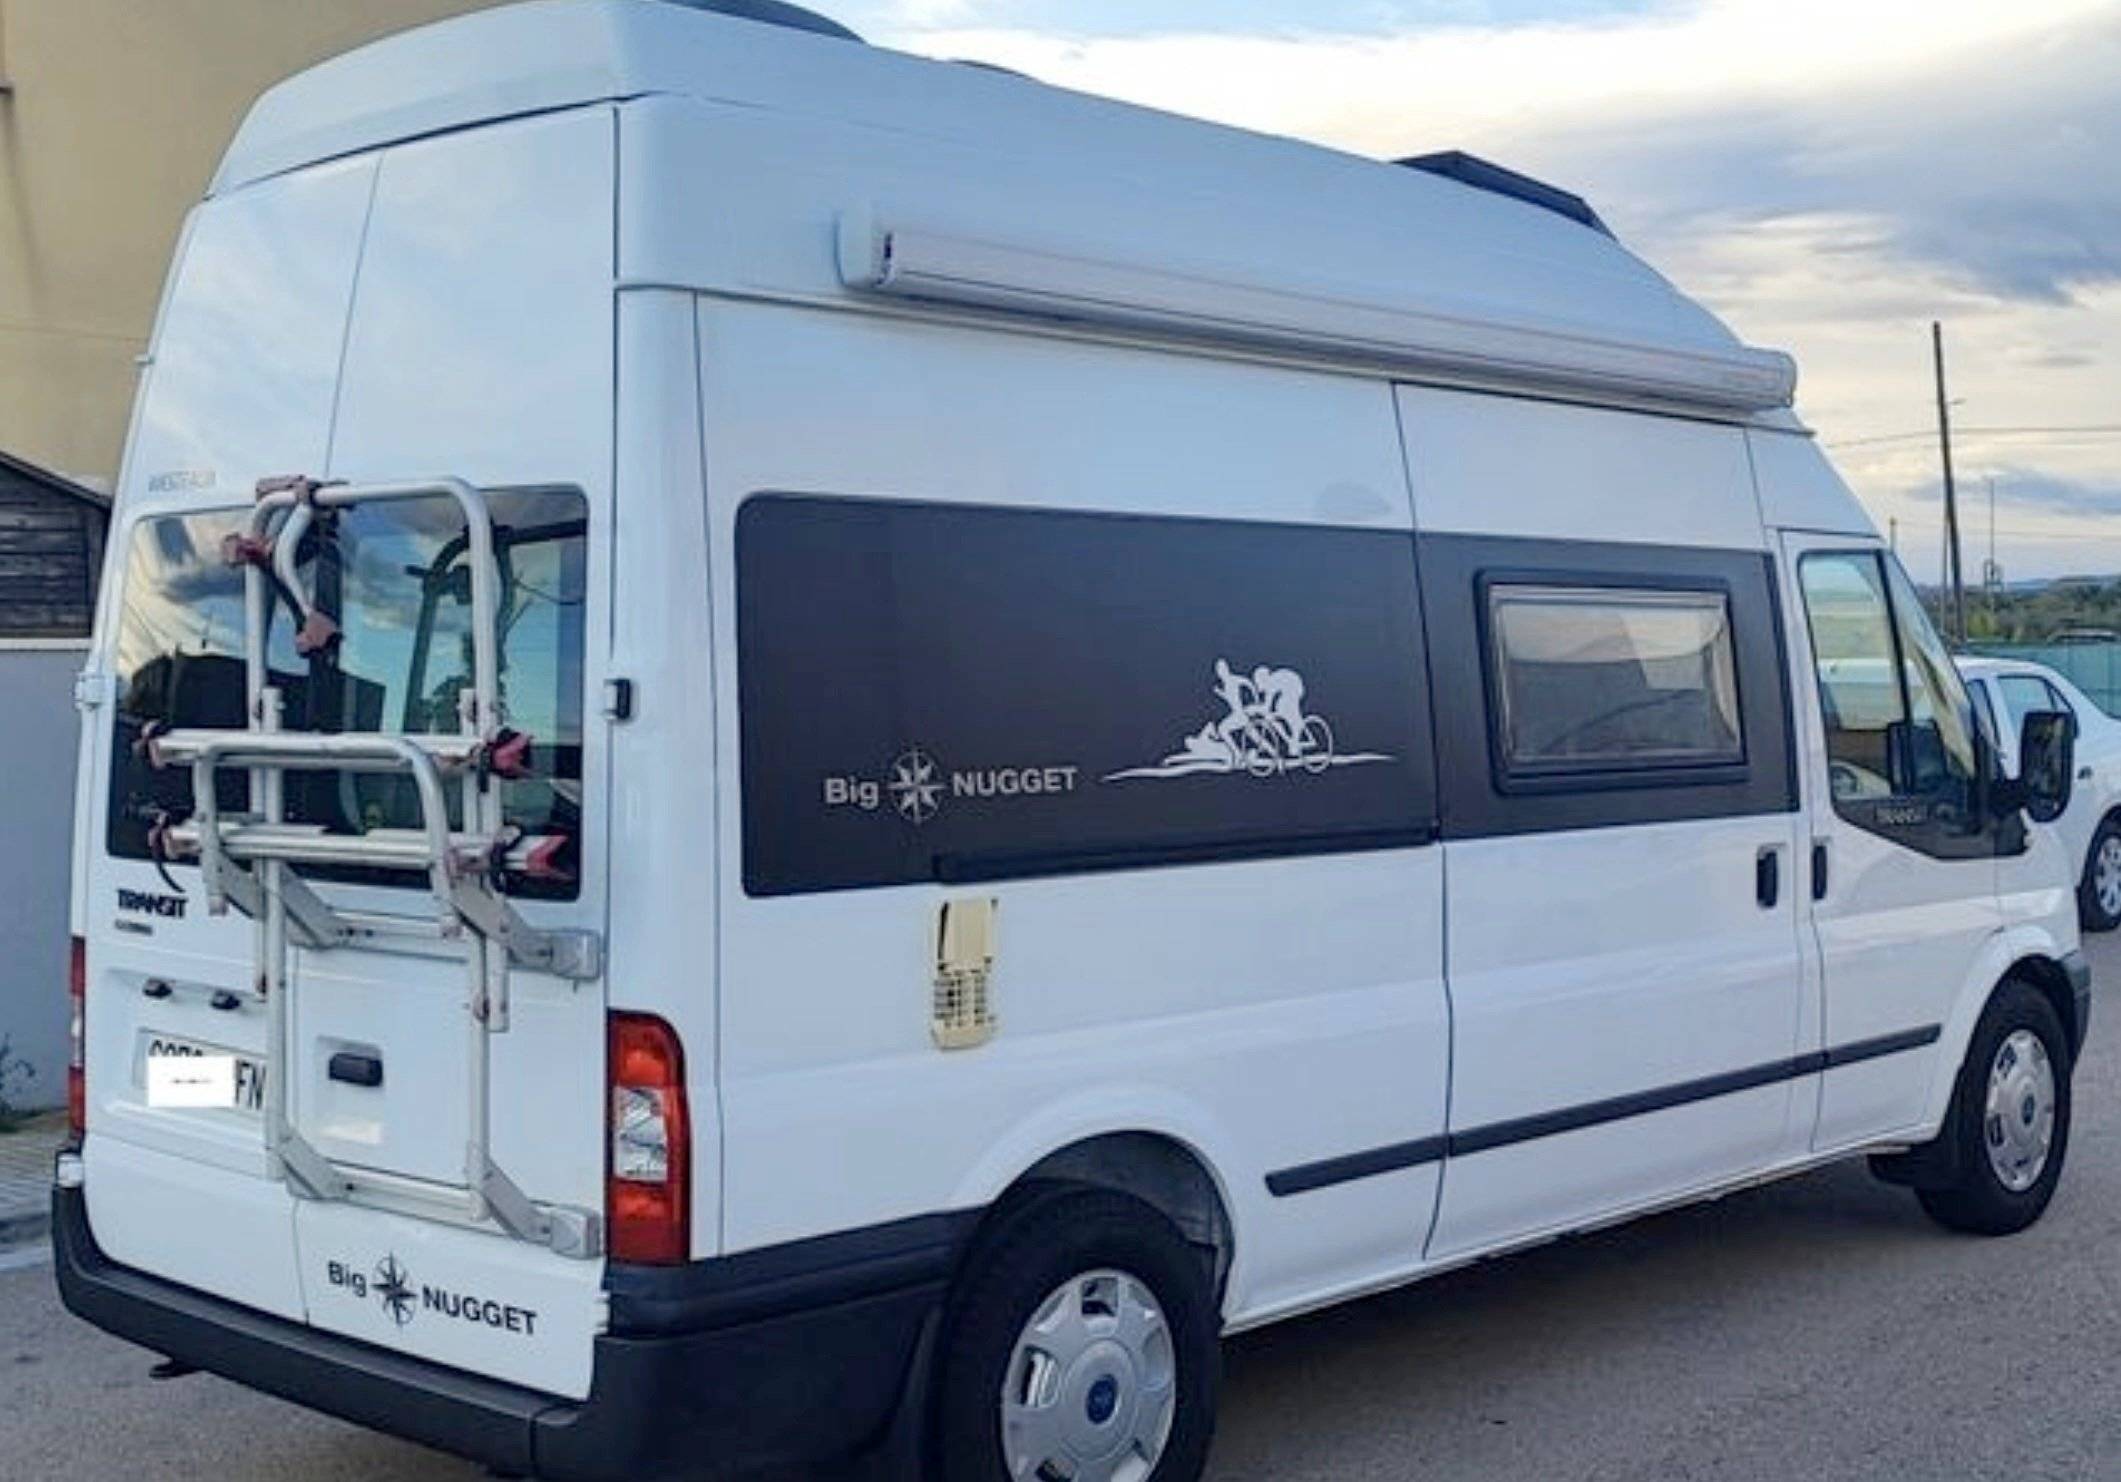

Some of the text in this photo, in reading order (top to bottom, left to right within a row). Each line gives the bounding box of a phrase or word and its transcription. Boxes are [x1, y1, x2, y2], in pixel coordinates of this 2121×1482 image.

[825, 766, 1078, 809] Big NUGGET
[117, 888, 188, 919] TRANSIT
[328, 1260, 537, 1334] Big NUGGET
